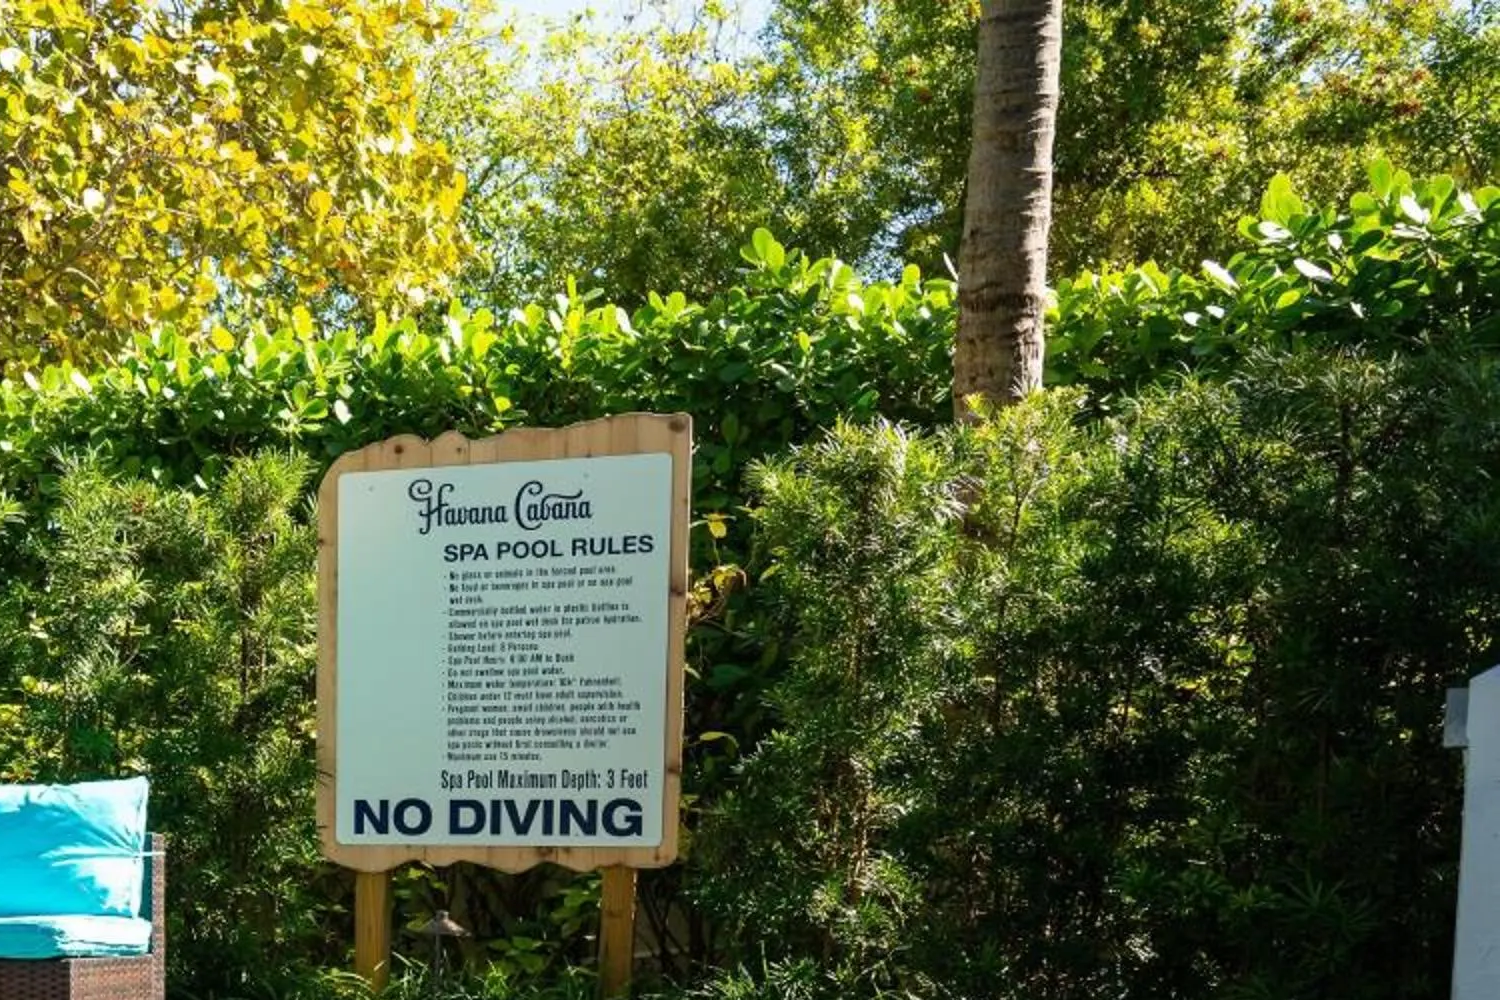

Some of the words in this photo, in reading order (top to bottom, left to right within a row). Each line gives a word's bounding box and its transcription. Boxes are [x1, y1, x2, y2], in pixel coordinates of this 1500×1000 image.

[408, 479, 508, 534] Havana
[514, 480, 593, 531] Cabana
[444, 544, 489, 563] SPA
[497, 539, 564, 560] POOL
[571, 535, 655, 557] RULES
[441, 771, 463, 791] Spa
[467, 770, 494, 789] Pool
[497, 770, 558, 789] Maximum
[561, 770, 602, 791] Depth:
[606, 770, 616, 789] 3
[619, 770, 649, 788] Feet
[354, 799, 433, 837] NO
[449, 799, 643, 837] DIVING
